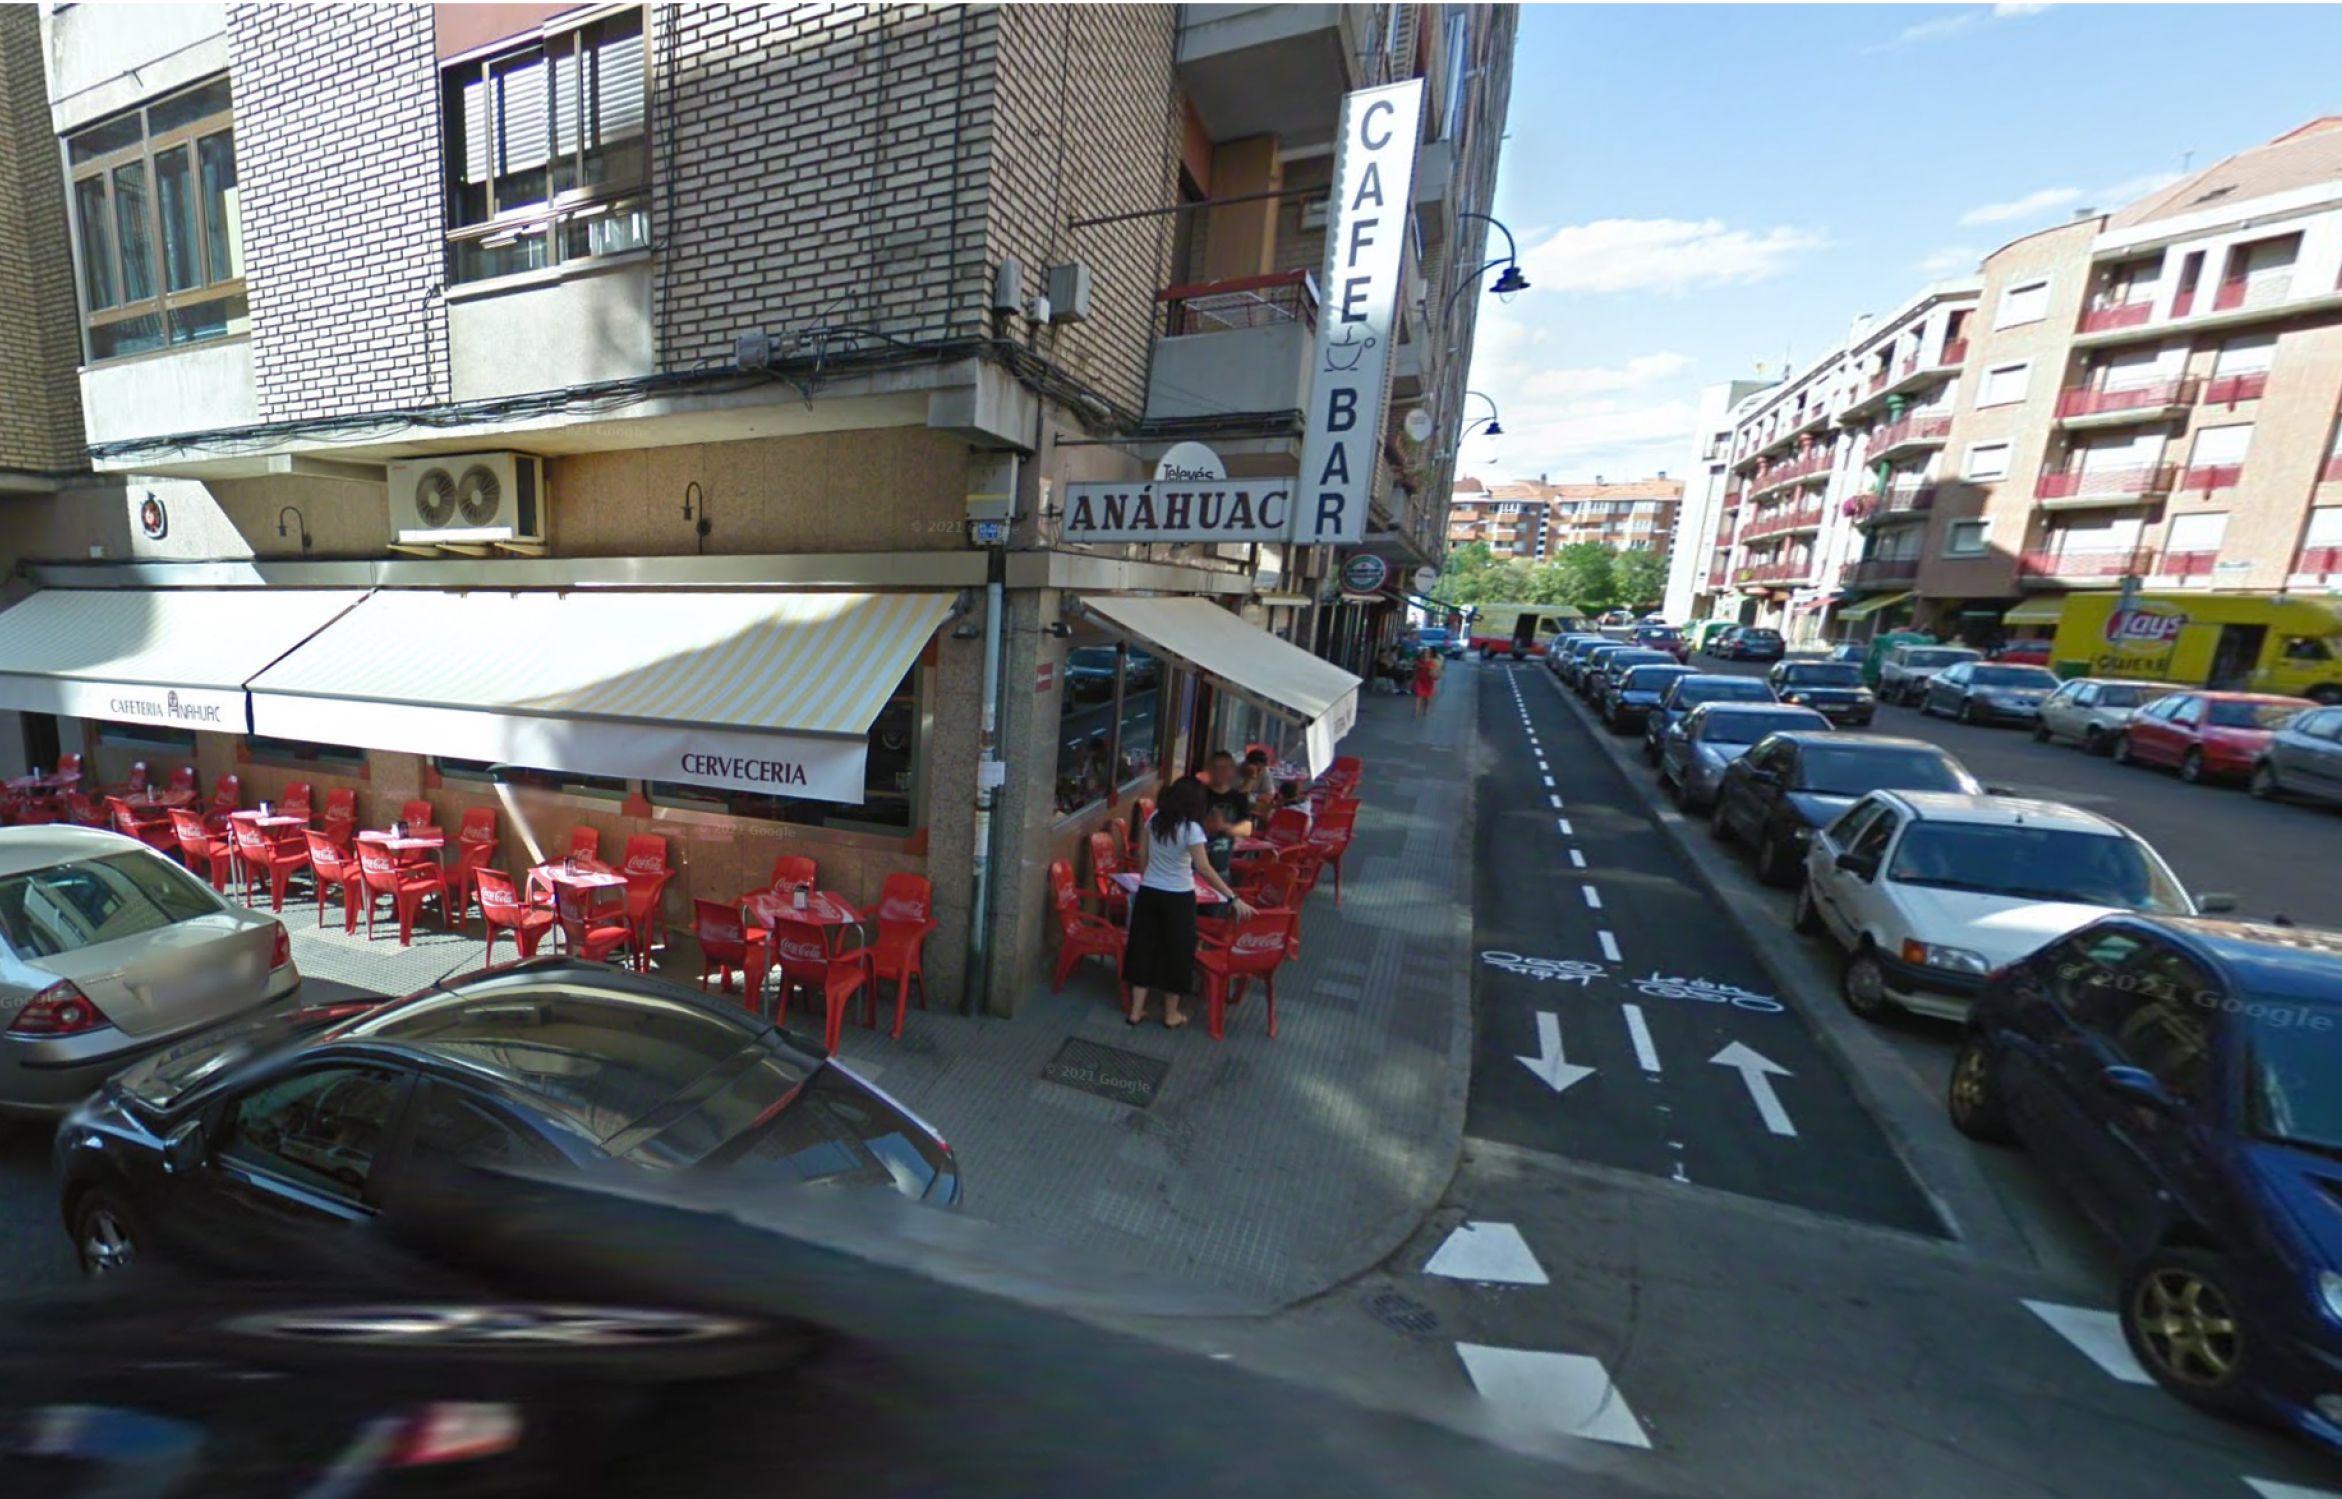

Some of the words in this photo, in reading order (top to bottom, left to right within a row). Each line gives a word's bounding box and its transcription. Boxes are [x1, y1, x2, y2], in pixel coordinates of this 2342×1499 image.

[1341, 99, 1395, 324] CAFE
[1315, 387, 1358, 536] BAR
[1067, 484, 1288, 531] ANÁHUAC
[110, 698, 164, 718] CAFETERIA
[681, 752, 807, 786] CERVECERIA
